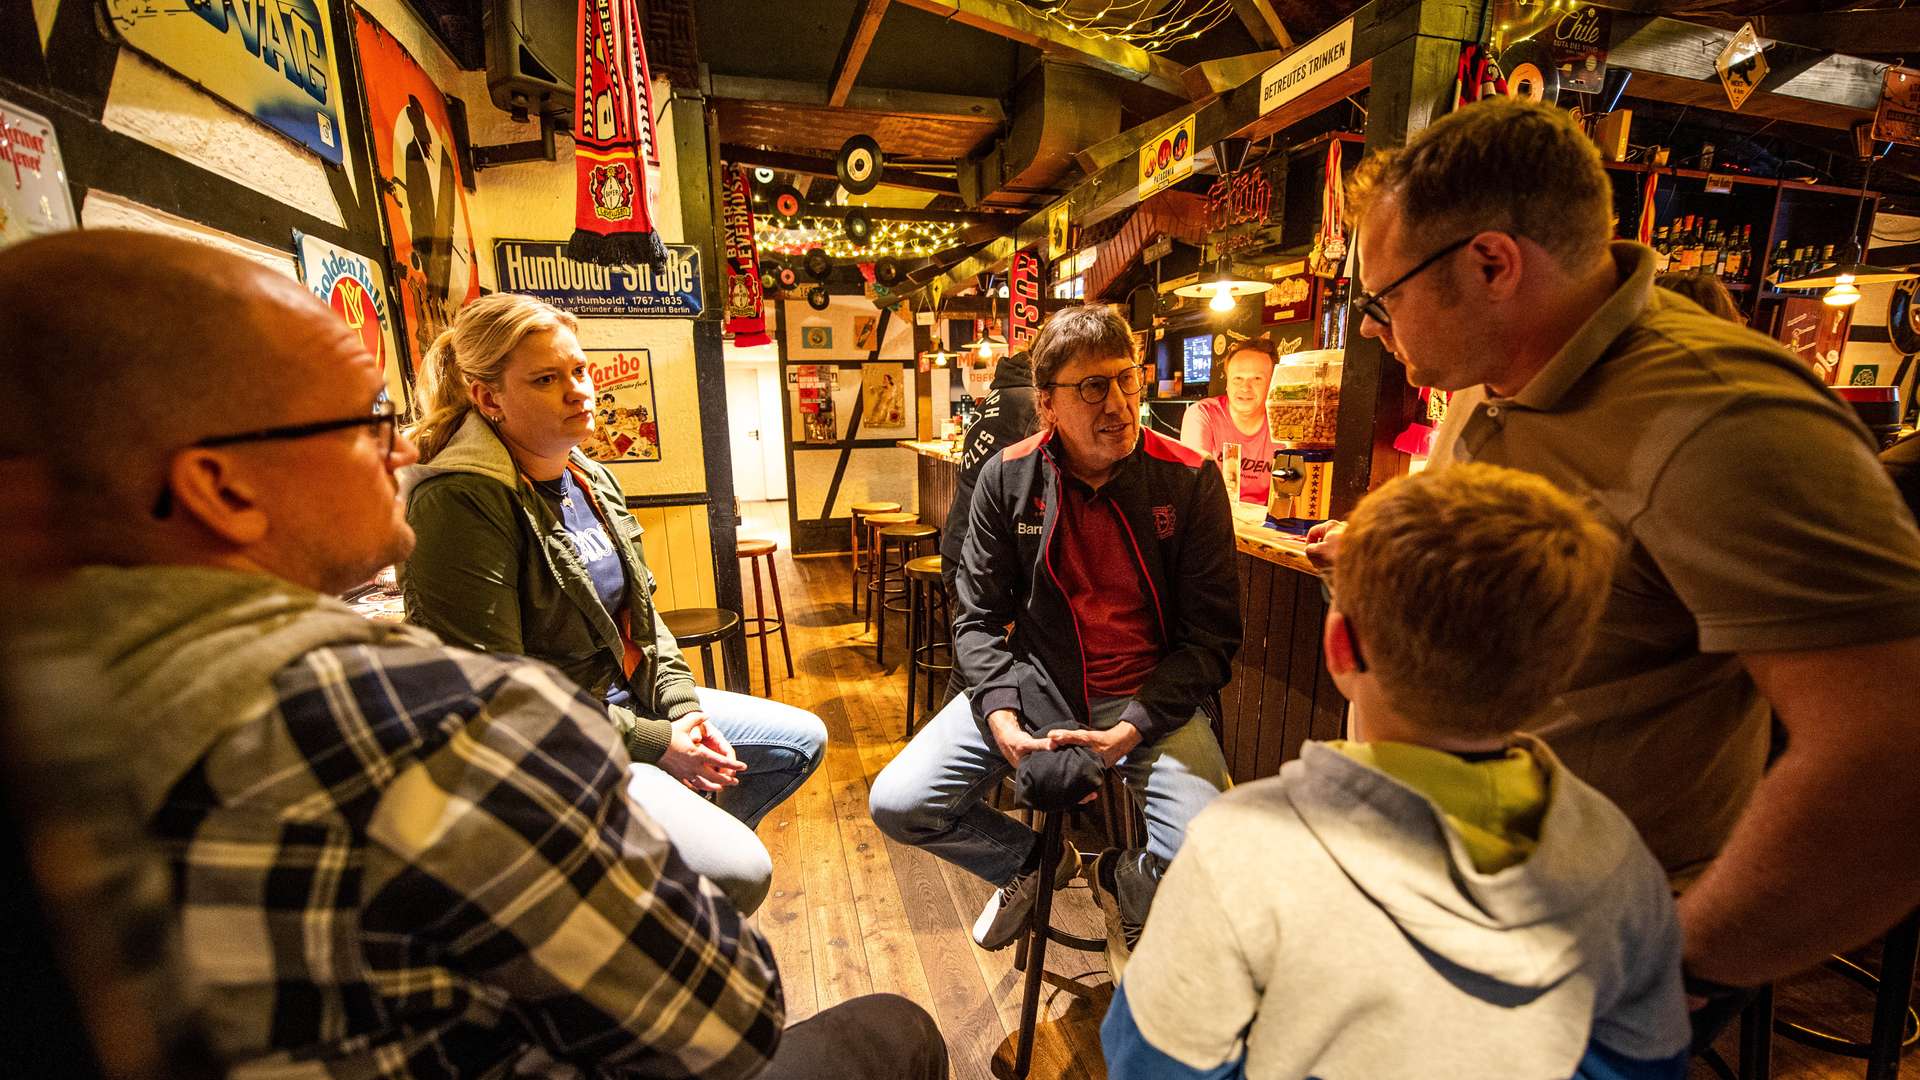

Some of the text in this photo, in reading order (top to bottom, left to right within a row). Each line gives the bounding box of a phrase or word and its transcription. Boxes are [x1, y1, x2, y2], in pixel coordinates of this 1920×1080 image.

[1556, 11, 1600, 43] Chile
[1264, 64, 1307, 101] BETREUTES
[1309, 40, 1346, 75] TRINKEN
[723, 206, 737, 258] BAYER
[356, 257, 389, 331] Tulip
[538, 296, 563, 305] helm
[669, 306, 690, 314] Berlin
